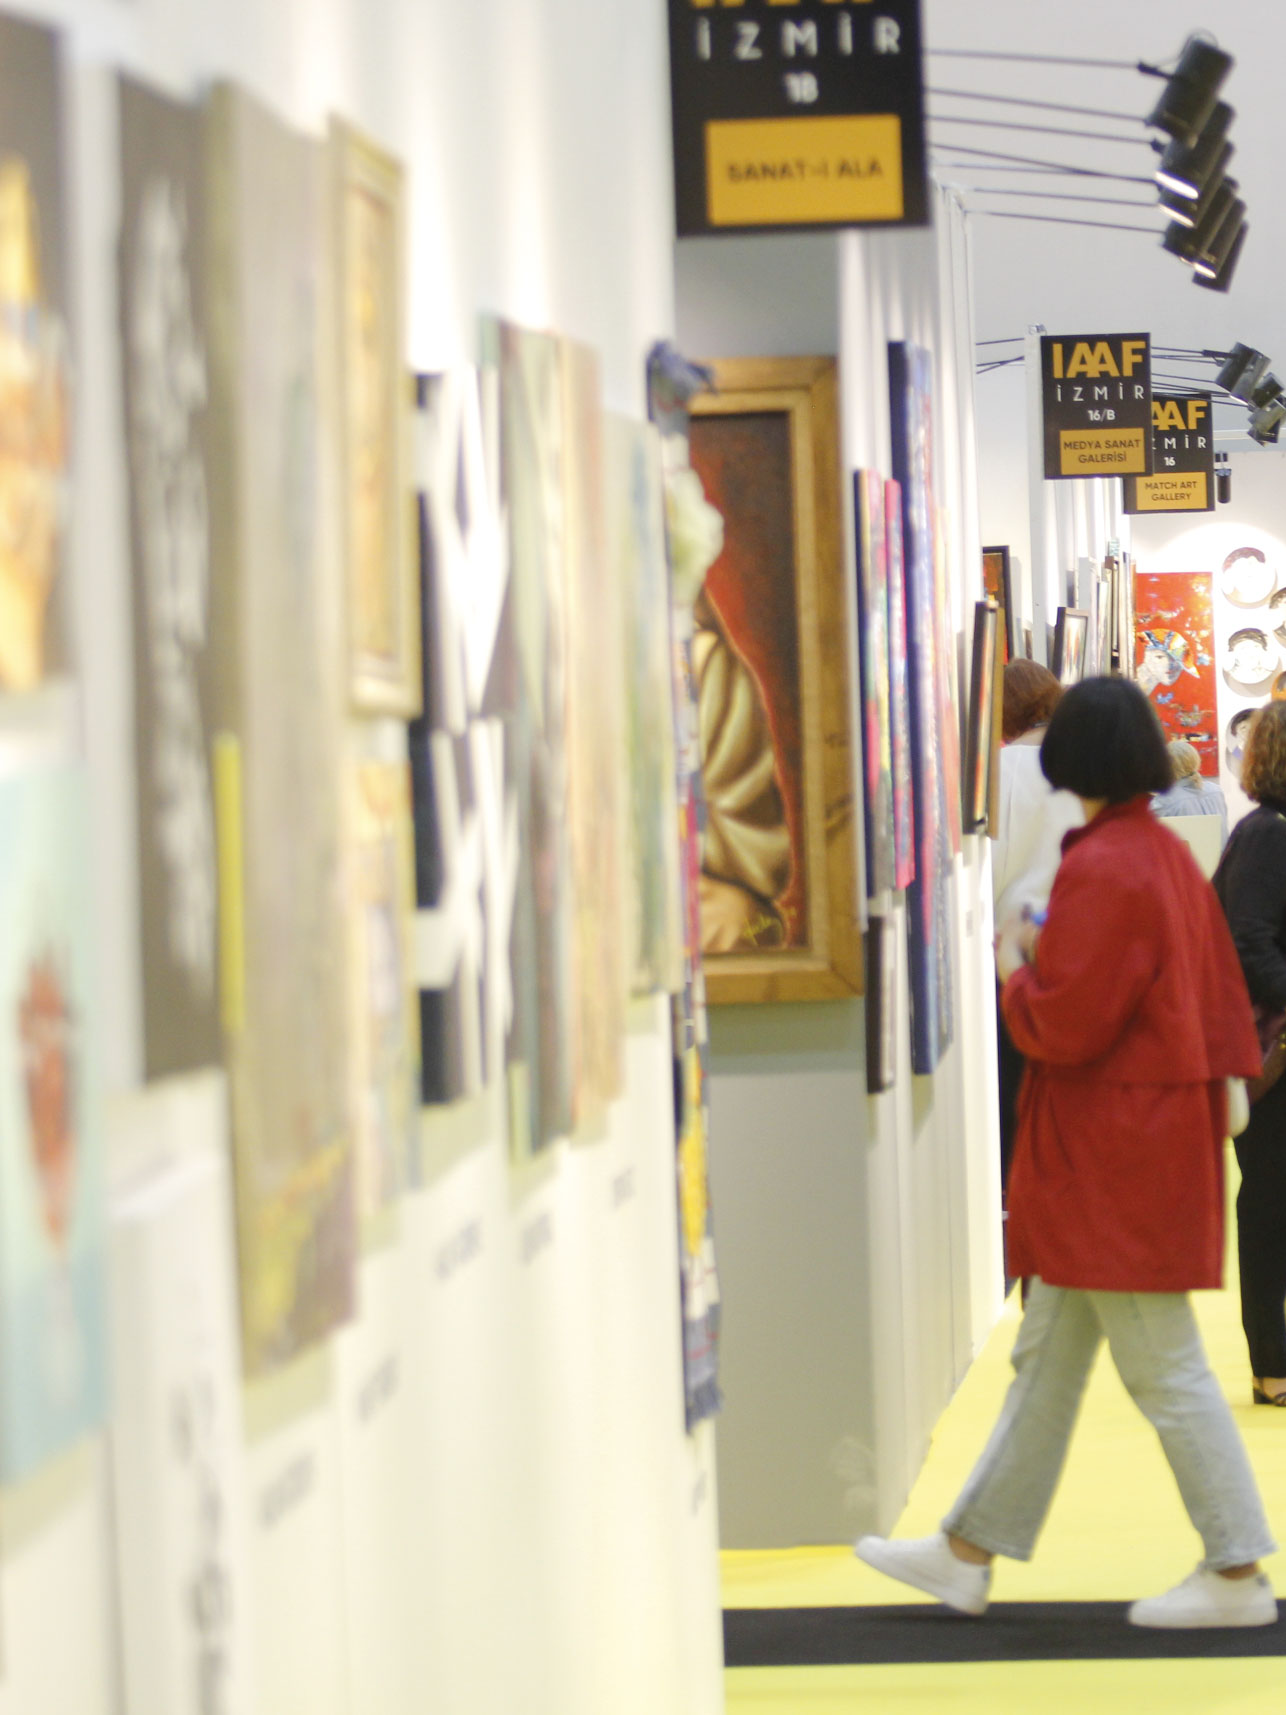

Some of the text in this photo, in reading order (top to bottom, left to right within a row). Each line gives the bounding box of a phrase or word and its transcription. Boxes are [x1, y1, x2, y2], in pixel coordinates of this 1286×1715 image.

[696, 11, 901, 61] İZMİR
[1052, 341, 1146, 379] IAAF
[1057, 382, 1145, 402] İZMİR
[1087, 409, 1116, 422] 16/B
[1064, 439, 1141, 450] MEDYA SANAT
[1078, 452, 1127, 464] GALERİSİ
[1164, 457, 1176, 467] 16
[1145, 481, 1197, 490] MATCH ART
[1152, 493, 1192, 501] GALLERY
